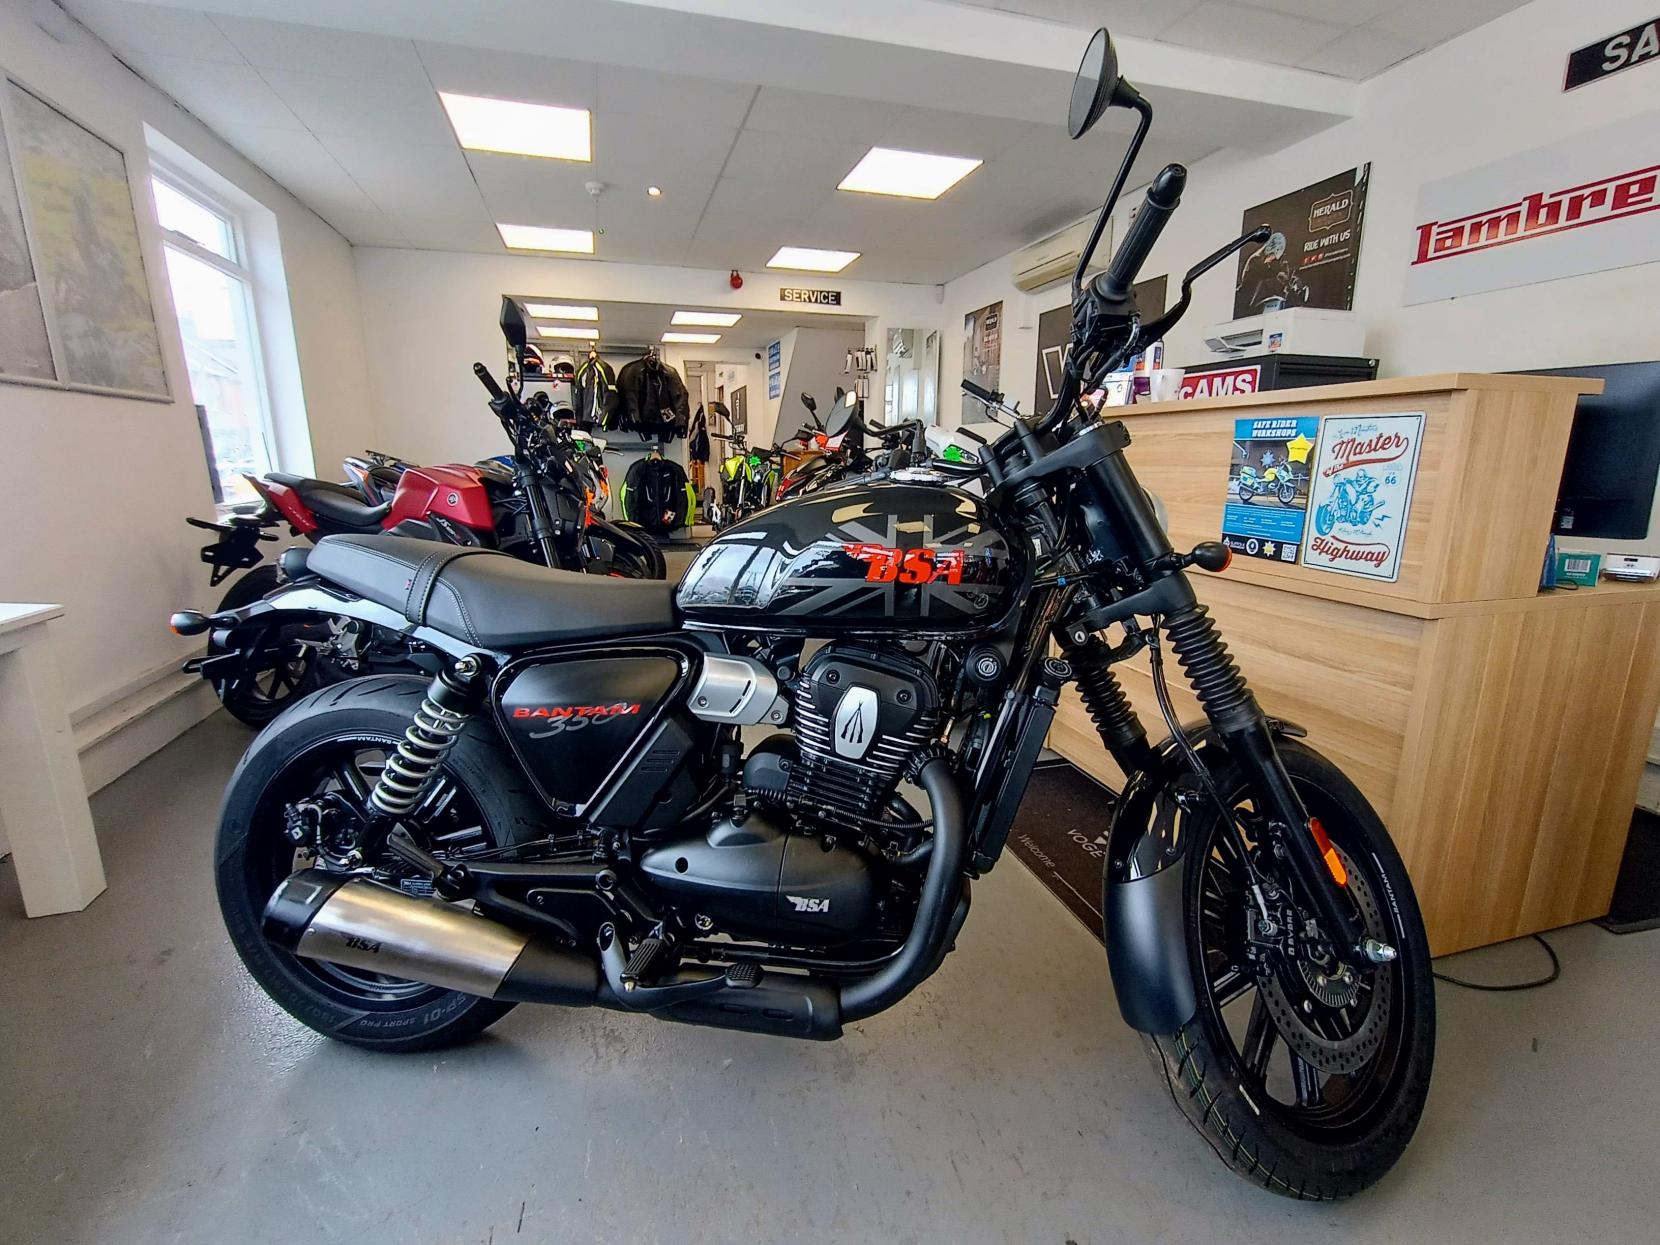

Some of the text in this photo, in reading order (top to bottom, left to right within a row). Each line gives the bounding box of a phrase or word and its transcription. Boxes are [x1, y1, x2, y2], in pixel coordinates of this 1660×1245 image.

[1602, 23, 1660, 71] SA
[1313, 199, 1349, 218] HERALD
[1303, 229, 1351, 252] RIDE WITH US
[784, 289, 837, 304] SERVICE
[1252, 420, 1298, 429] SAFE RIDER
[1252, 429, 1297, 438] WORKSHOPS
[1331, 432, 1407, 463] Master
[1384, 475, 1397, 485] 66
[1311, 536, 1390, 567] Highway
[843, 543, 963, 585] BSA
[512, 703, 641, 718] BANTAM
[528, 702, 627, 739] 350
[1018, 834, 1056, 868] Welcome
[1381, 873, 1399, 914] BANTAM
[787, 895, 830, 912] BSA
[346, 936, 383, 953] BSA
[384, 1017, 417, 1028] SPORT
